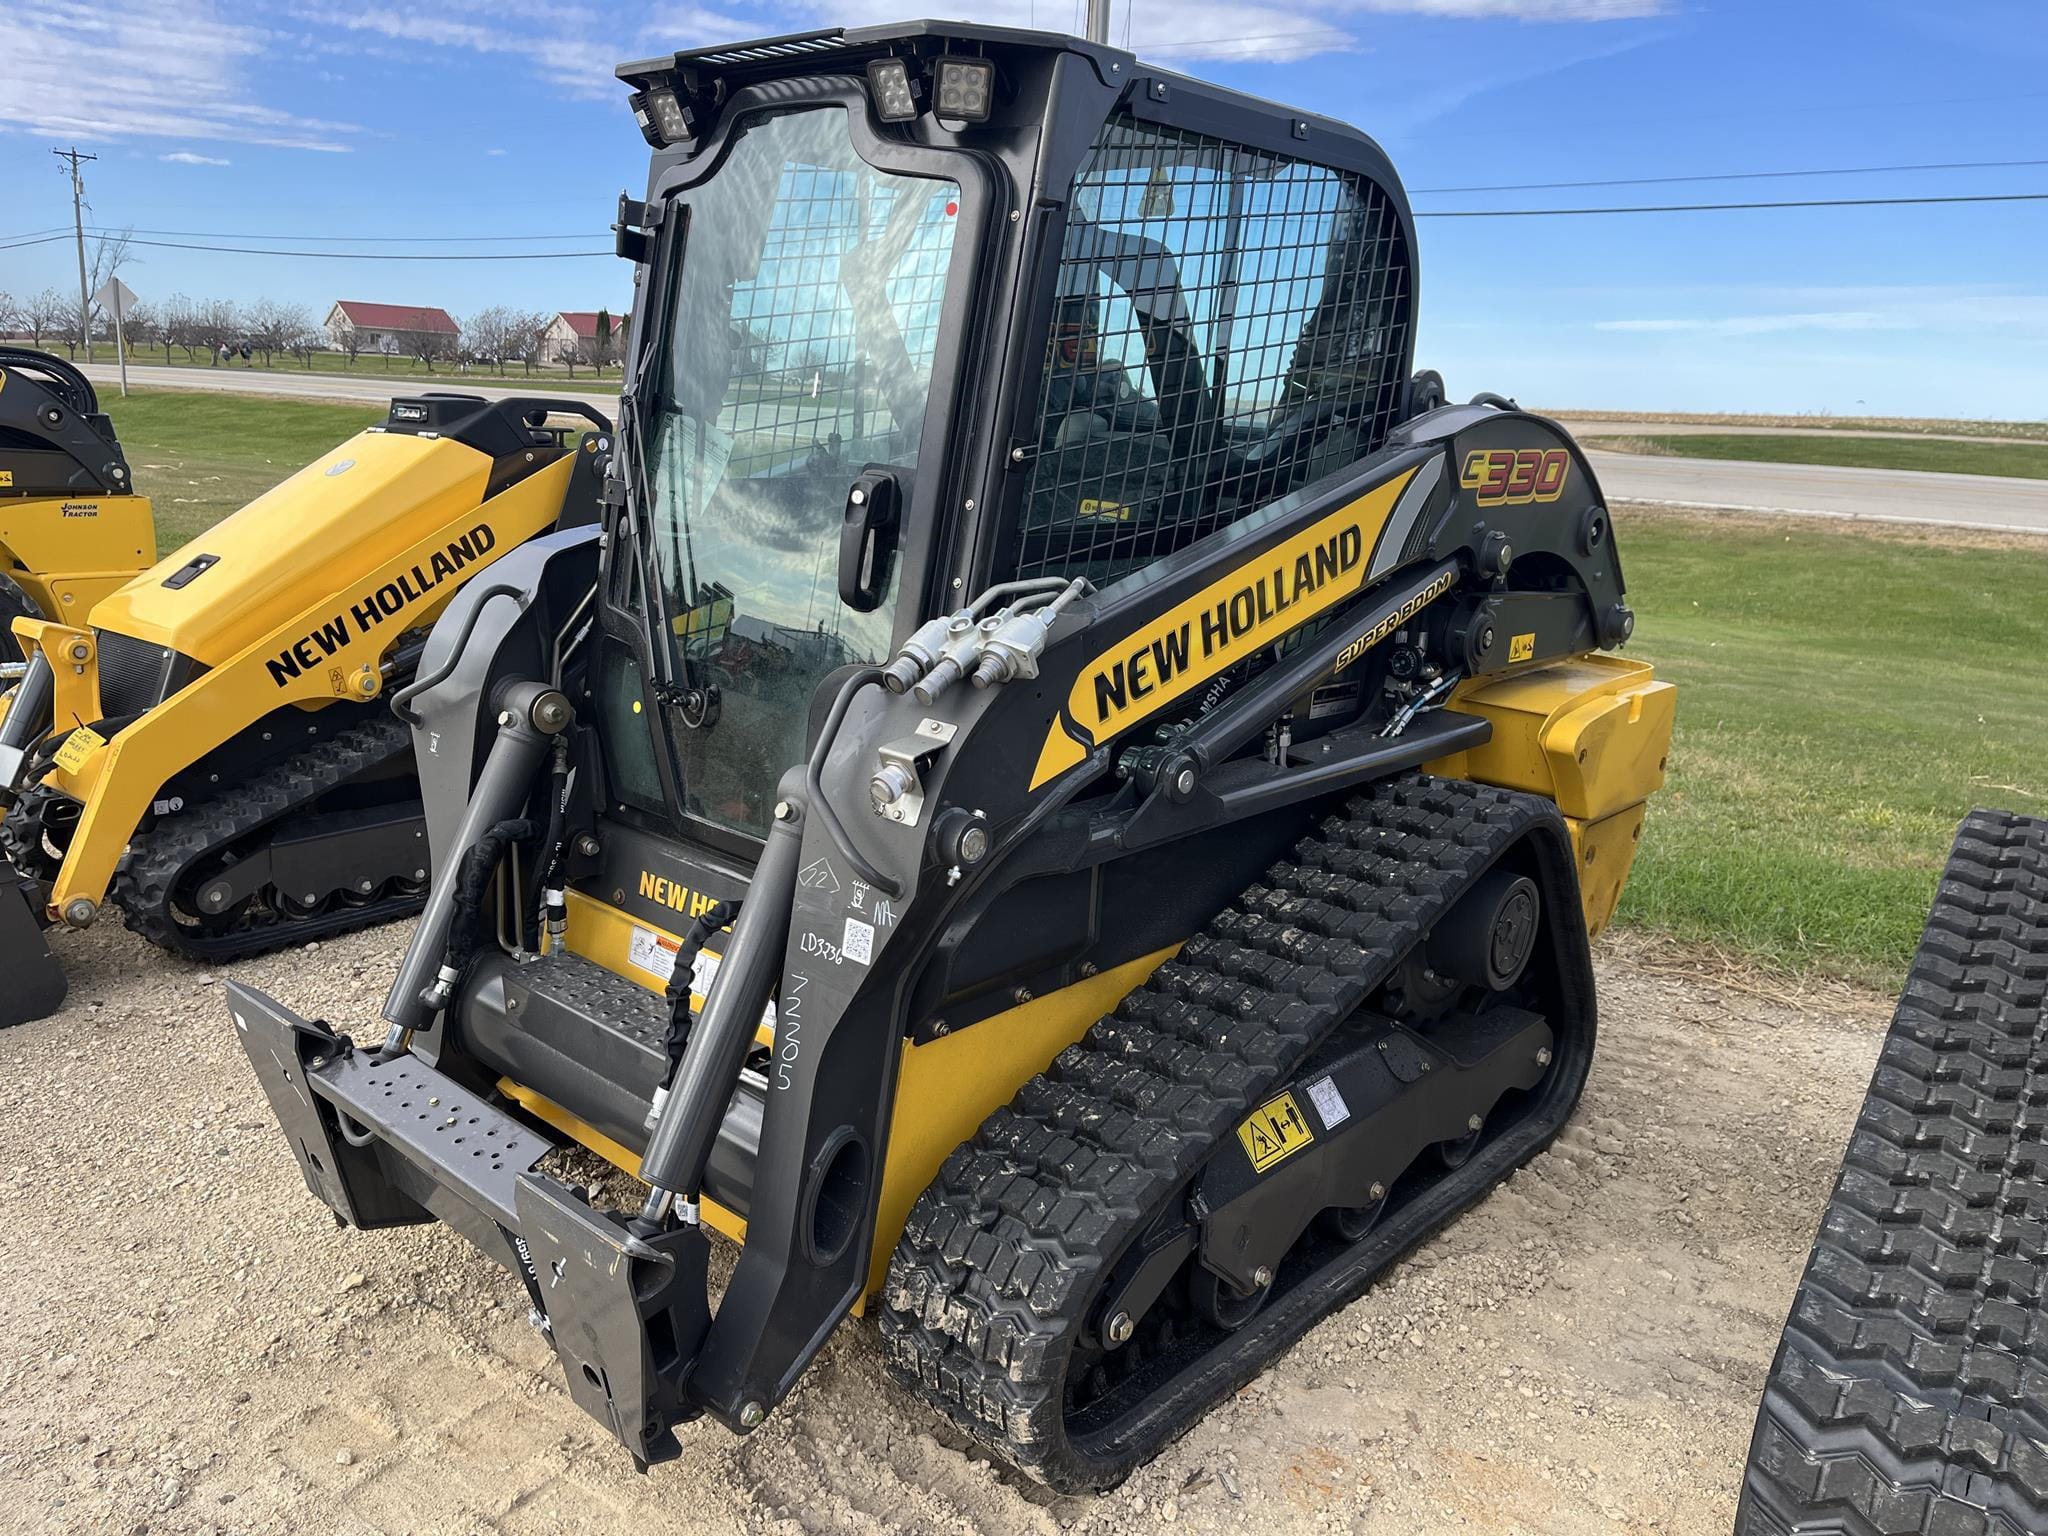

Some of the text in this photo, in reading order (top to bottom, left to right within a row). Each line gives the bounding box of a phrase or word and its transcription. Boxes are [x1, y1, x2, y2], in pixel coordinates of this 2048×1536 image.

[265, 523, 496, 688] NEW HOLLAND
[1093, 523, 1362, 724] NEW HOLLAND
[1335, 611, 1400, 674] SUPER
[1400, 571, 1452, 621] BOOM
[1200, 676, 1231, 714] MSHA
[639, 870, 689, 913] NEW
[800, 932, 843, 965] LD3236
[777, 973, 809, 1090] 72205
